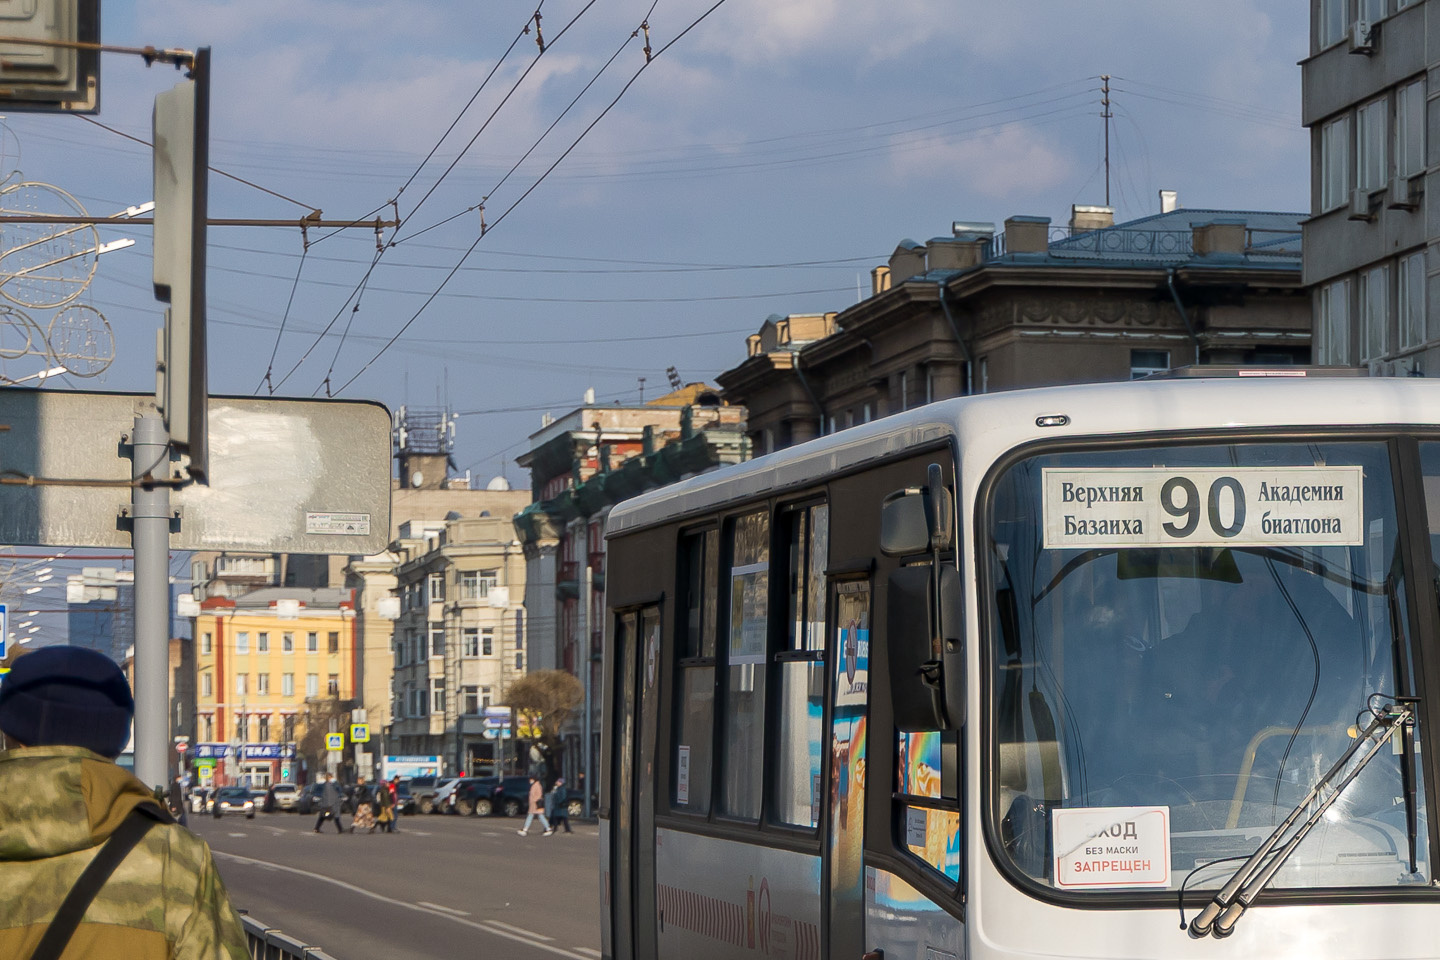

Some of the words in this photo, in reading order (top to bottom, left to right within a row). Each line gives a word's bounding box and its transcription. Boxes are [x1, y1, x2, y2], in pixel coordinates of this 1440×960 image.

[1061, 481, 1144, 508] Верхняя
[1257, 481, 1344, 506] Академия
[1160, 476, 1247, 538] 90
[1063, 515, 1144, 536] Базаиха
[1260, 511, 1342, 535] биатлона
[1088, 821, 1138, 840] ХОД
[1085, 846, 1104, 855] БЕЗ
[1106, 846, 1139, 855] МАСКИ
[1074, 860, 1151, 873] ЗАПРЕЩЕН
